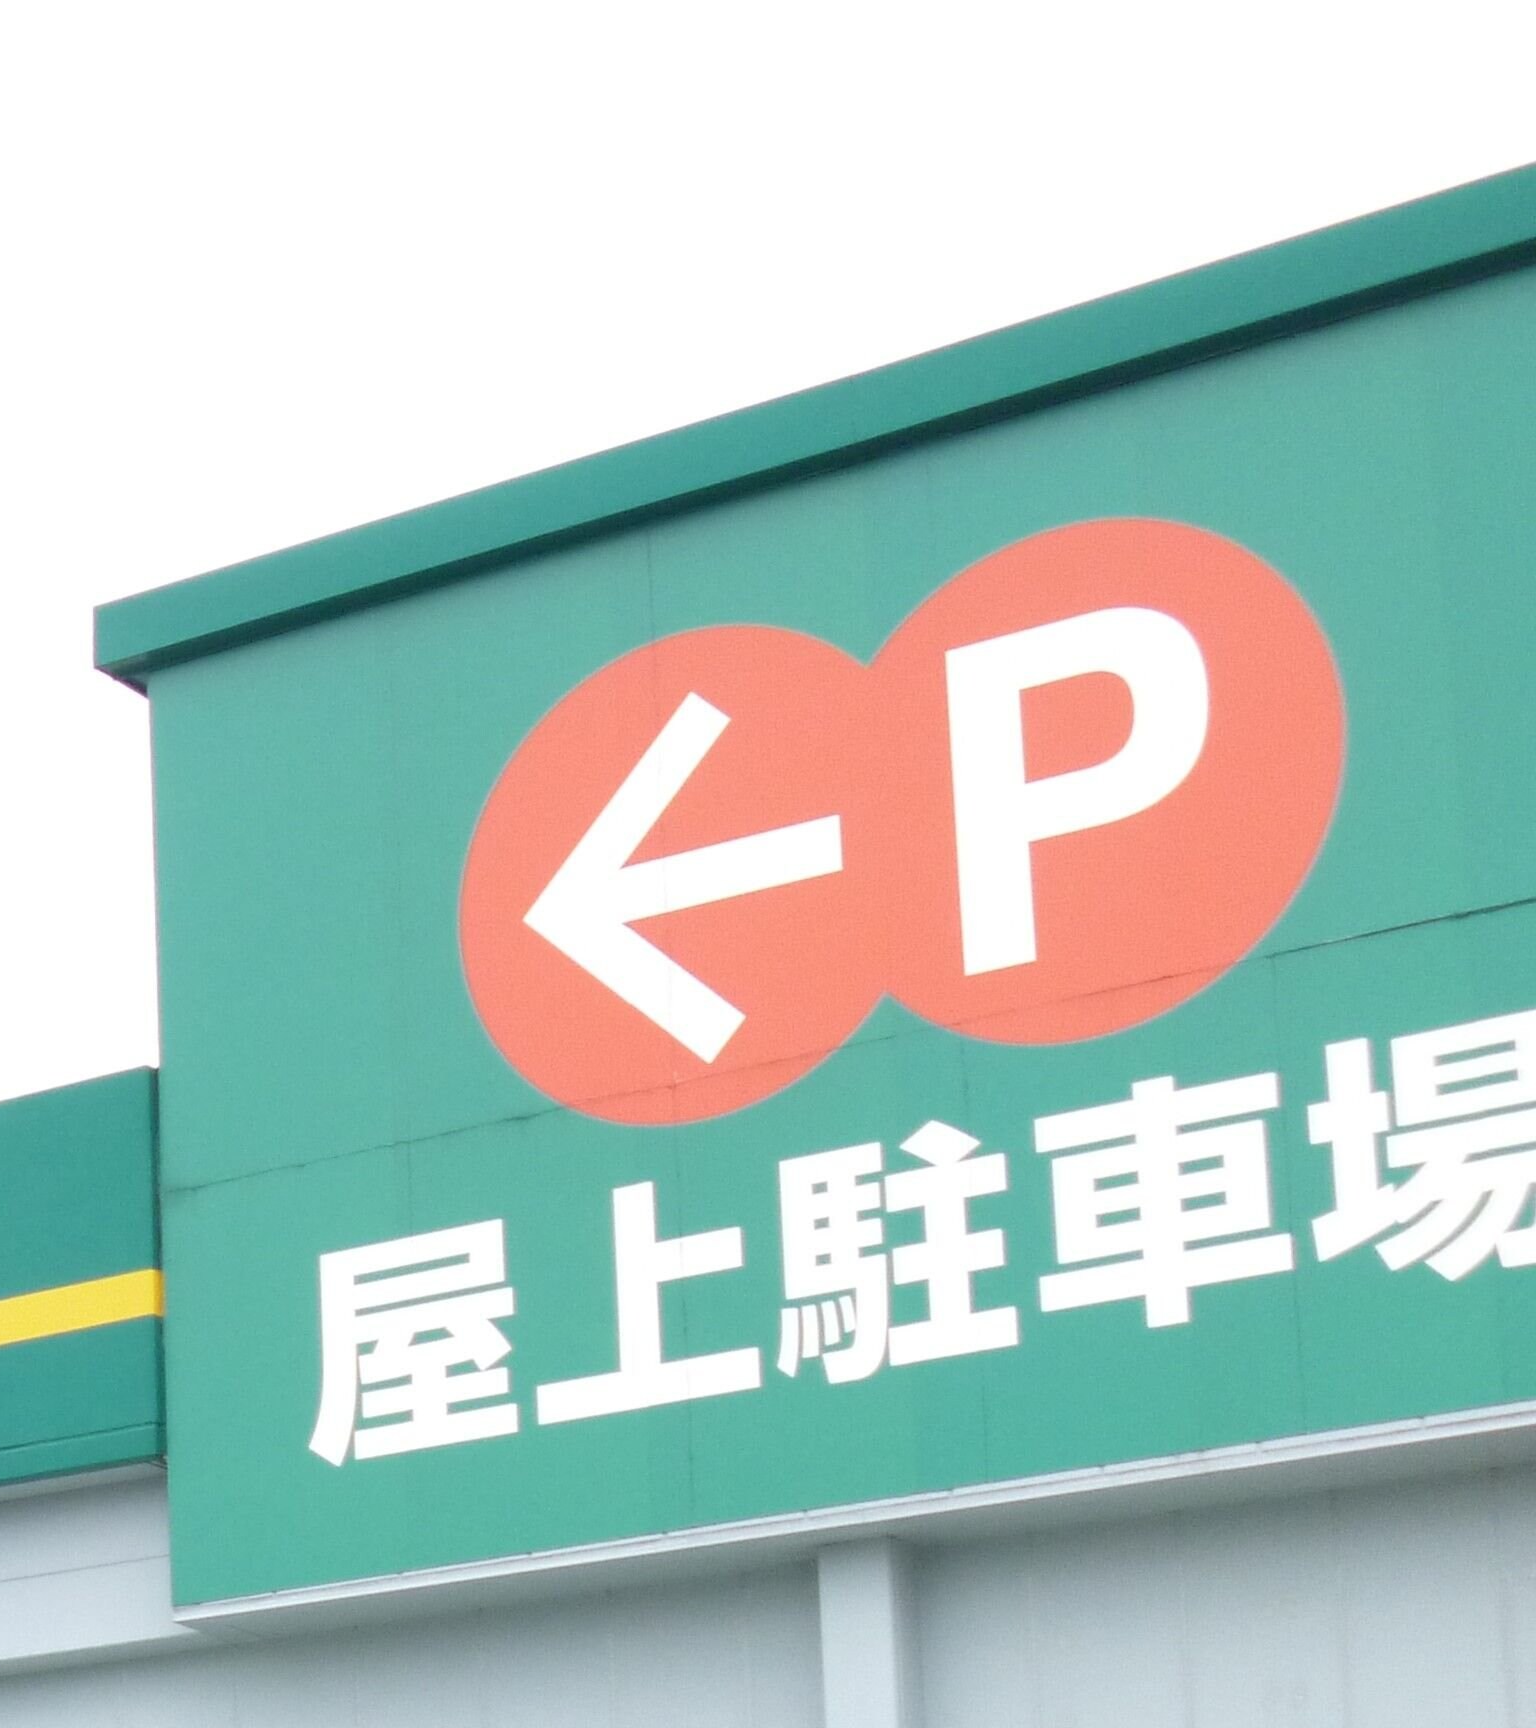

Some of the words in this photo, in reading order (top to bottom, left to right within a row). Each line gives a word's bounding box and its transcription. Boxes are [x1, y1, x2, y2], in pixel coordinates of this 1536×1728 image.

[945, 606, 1210, 976] P
[308, 1007, 1536, 1467] 屋上駐車場
